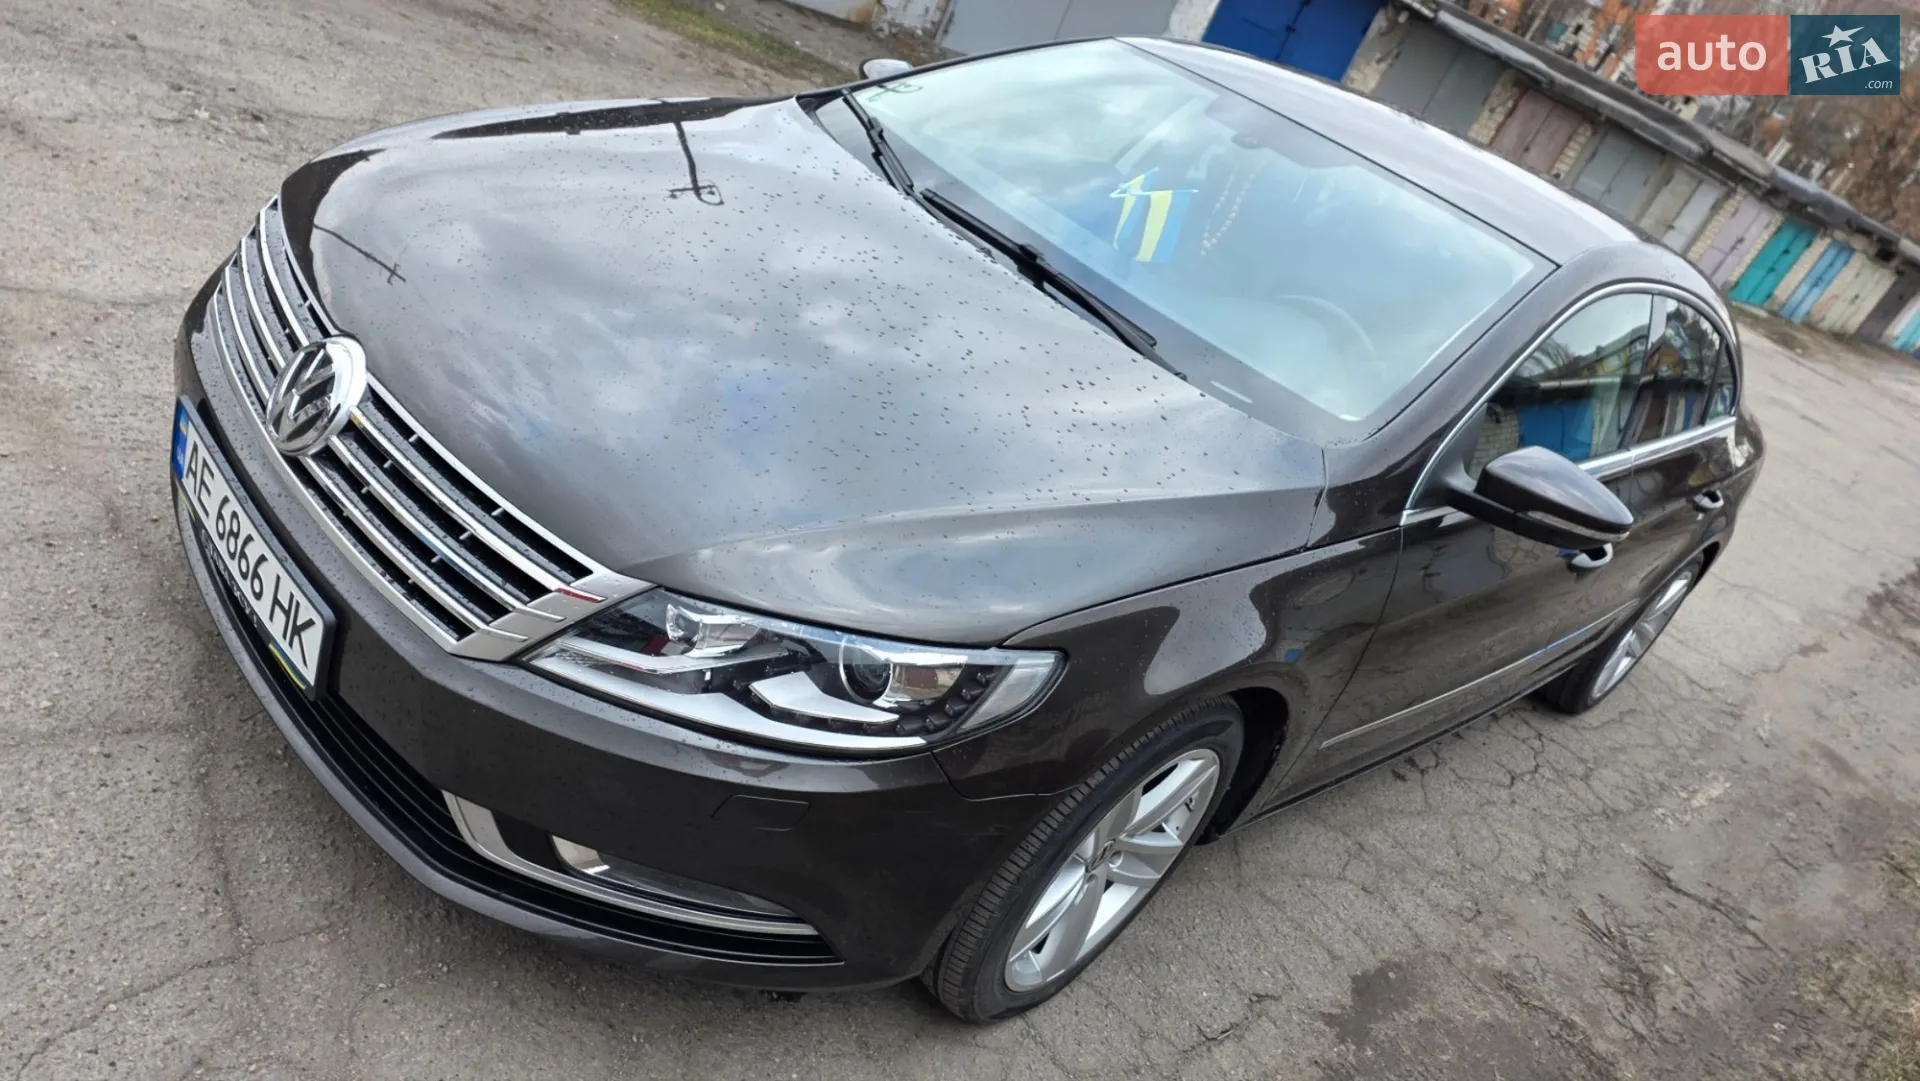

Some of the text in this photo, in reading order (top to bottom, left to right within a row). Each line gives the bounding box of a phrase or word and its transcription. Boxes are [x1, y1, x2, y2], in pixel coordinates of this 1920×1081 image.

[185, 439, 215, 521] AE
[215, 494, 268, 602] 6866
[268, 572, 317, 669] HK
